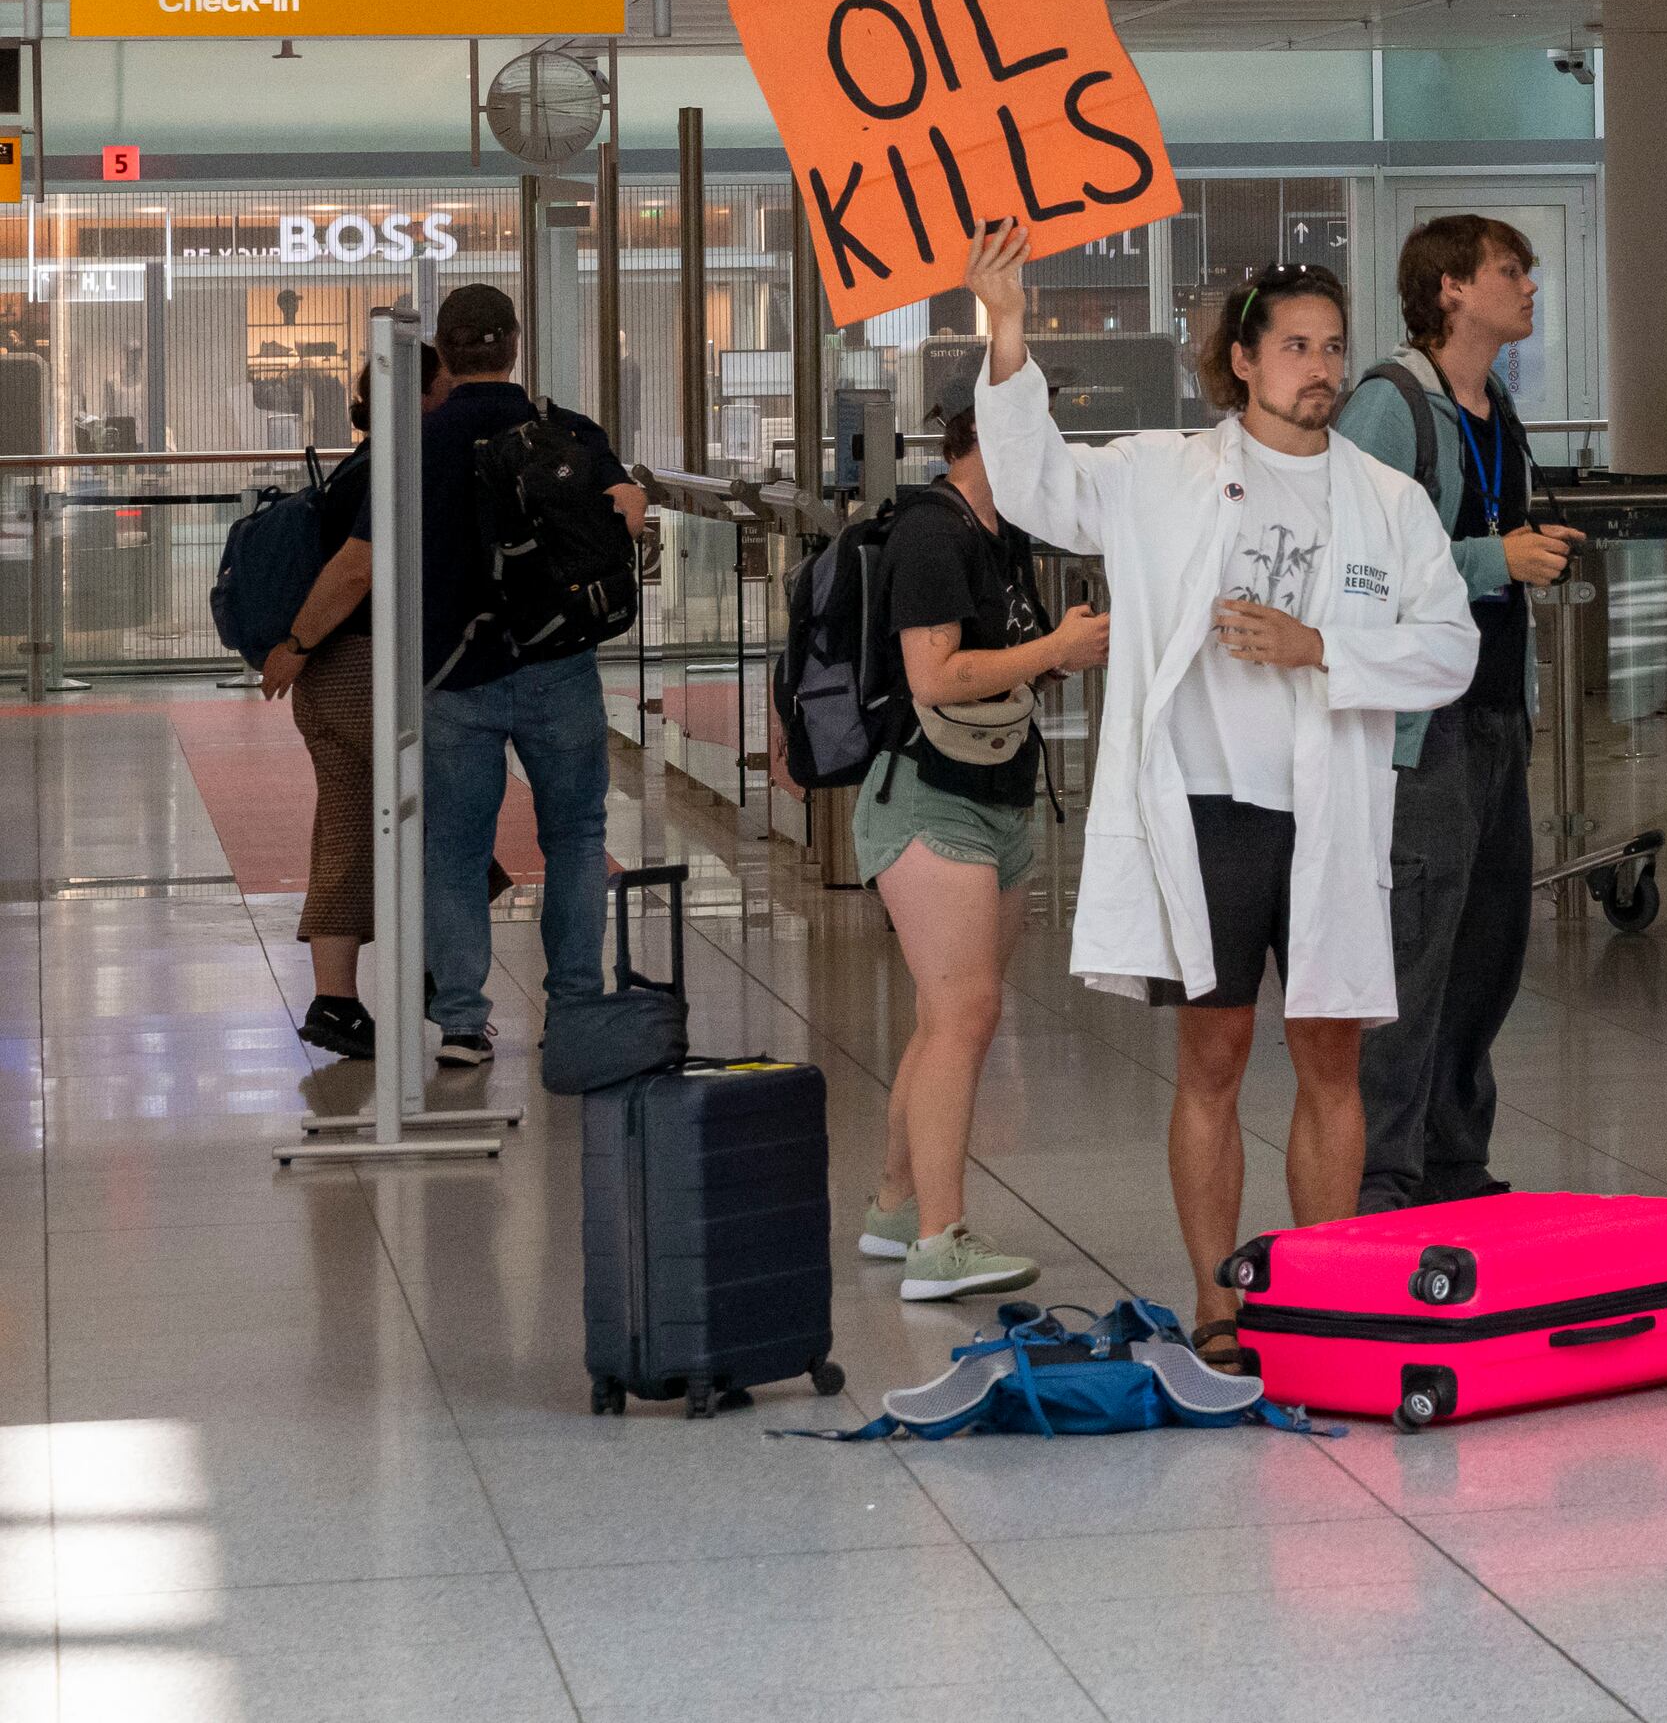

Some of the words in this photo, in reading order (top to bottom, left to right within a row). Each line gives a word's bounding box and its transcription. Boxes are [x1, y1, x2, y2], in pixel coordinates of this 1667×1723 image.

[115, 153, 128, 173] 5
[809, 72, 1153, 288] KILLS
[279, 213, 458, 263] BOSS
